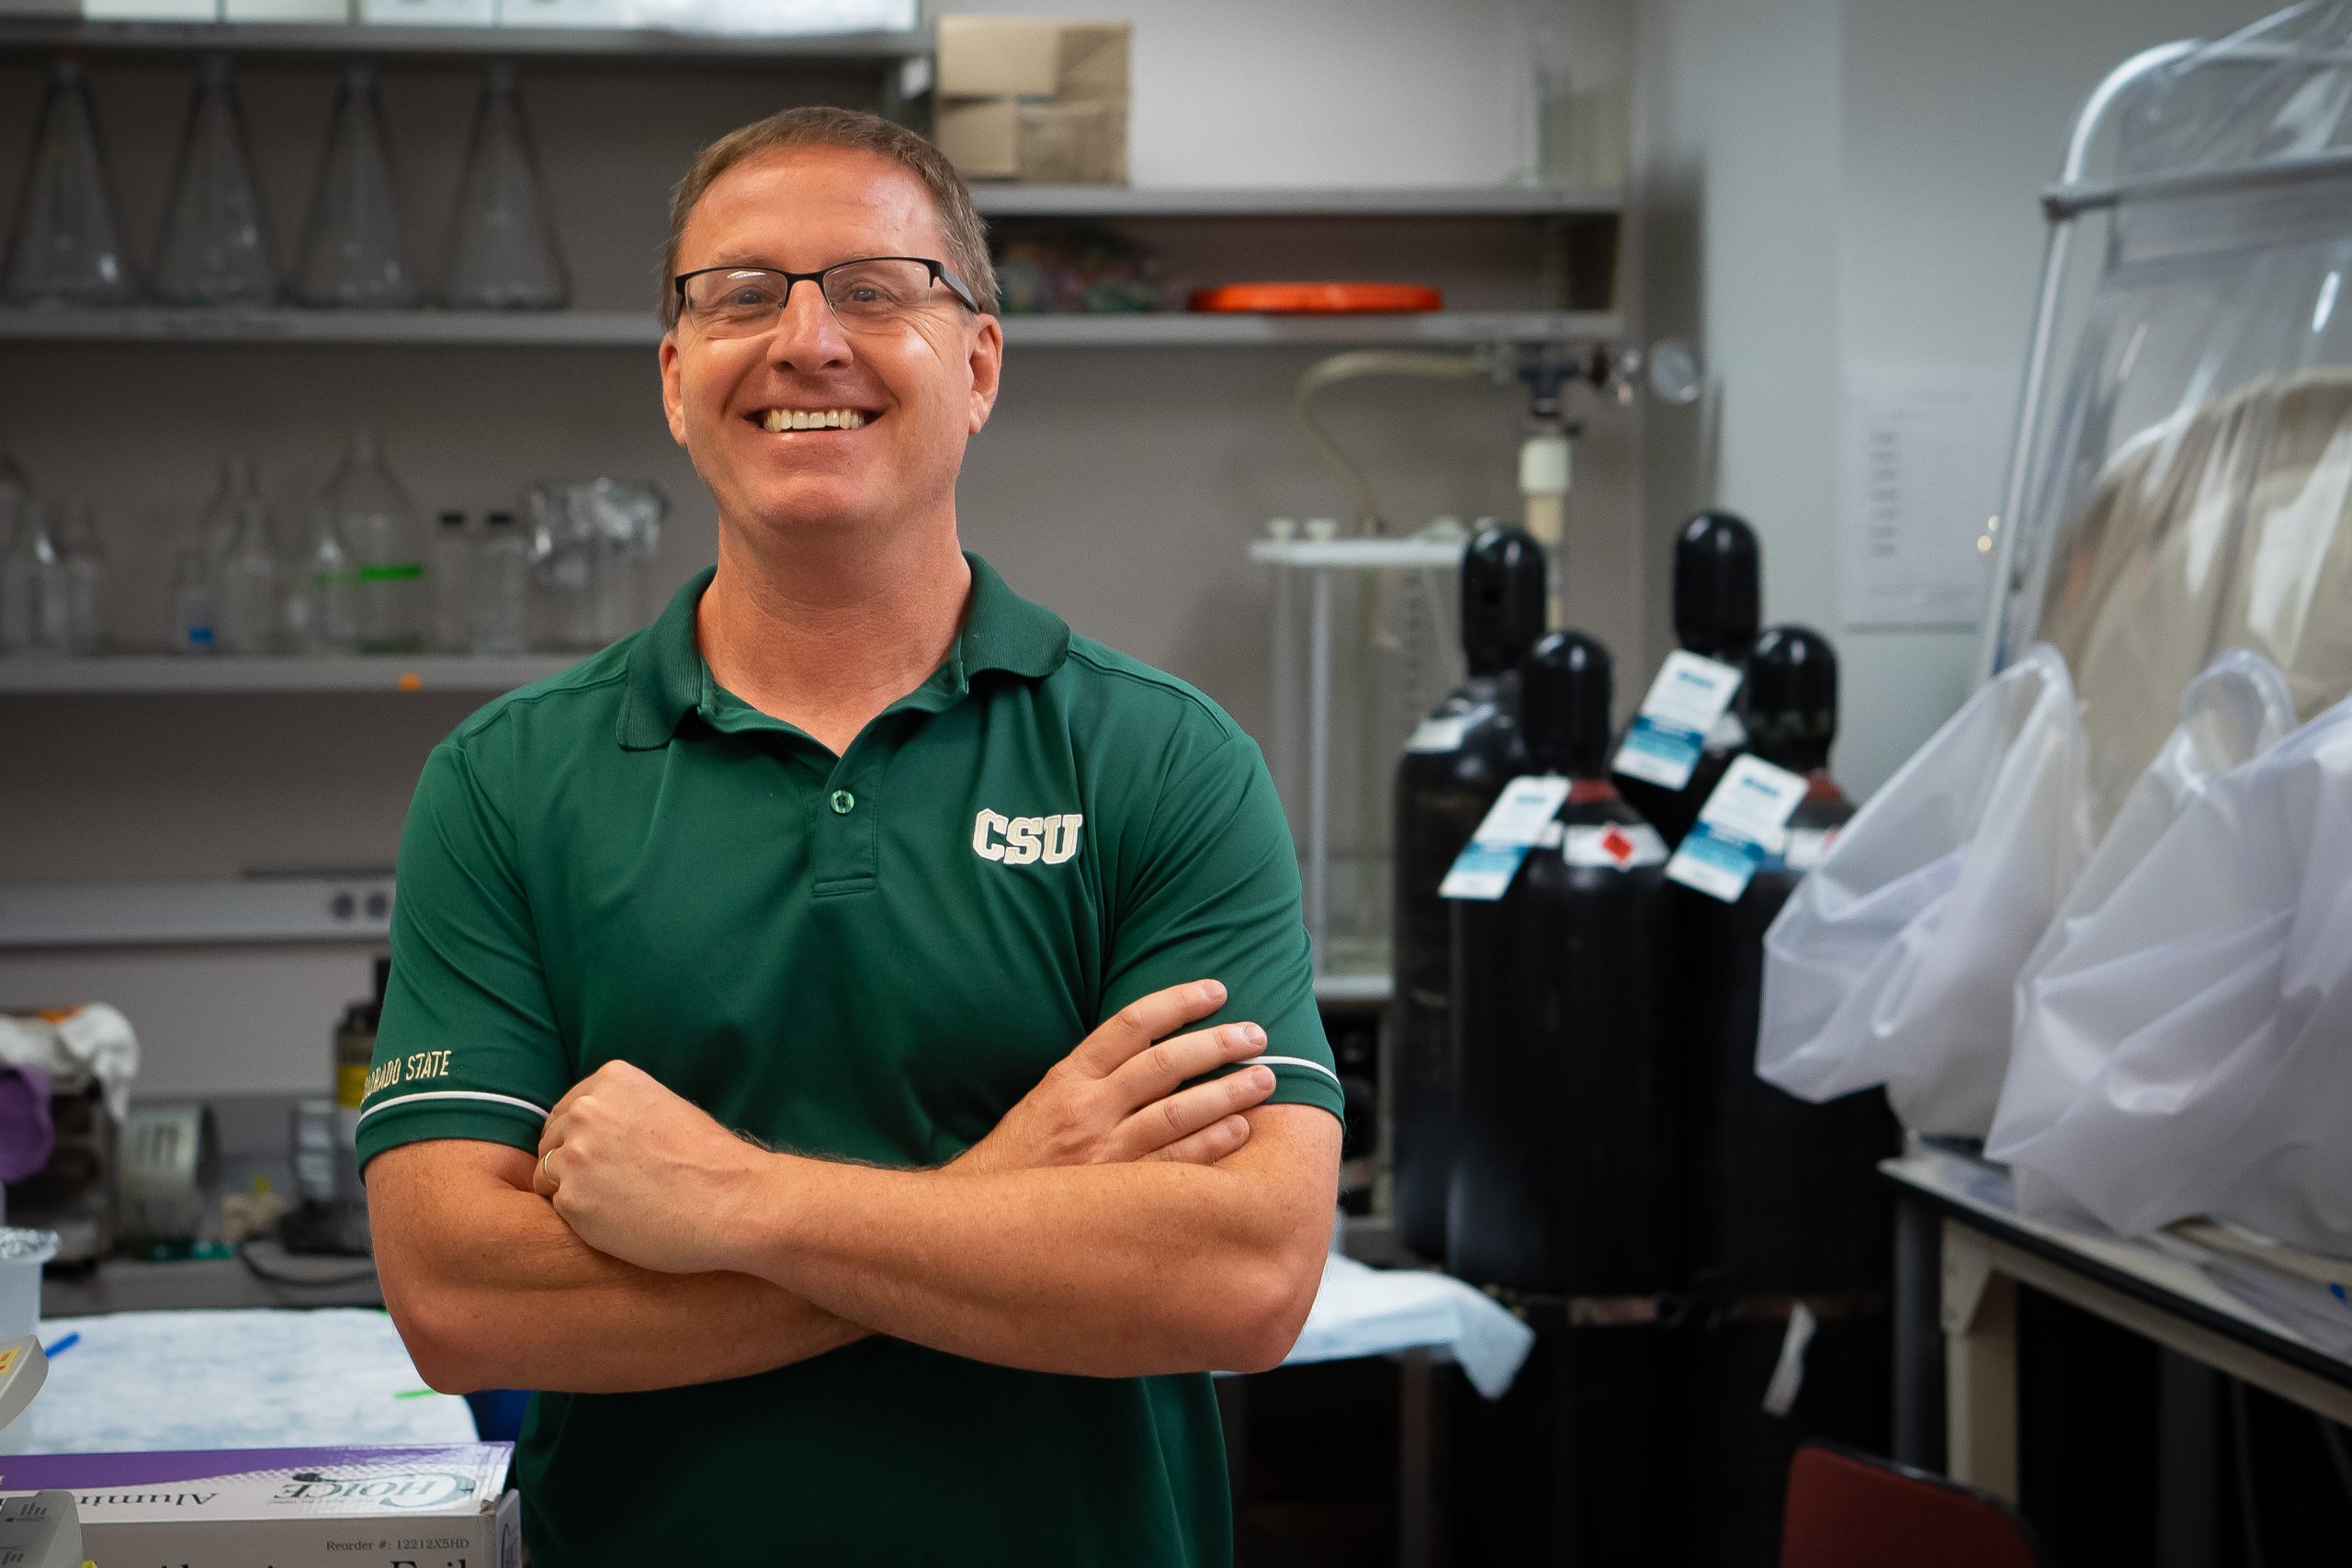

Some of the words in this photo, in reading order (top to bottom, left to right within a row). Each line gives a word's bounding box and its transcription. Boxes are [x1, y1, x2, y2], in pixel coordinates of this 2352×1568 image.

[973, 808, 1083, 864] CSU
[406, 1050, 452, 1081] STATE
[325, 1540, 374, 1551] Reorder
